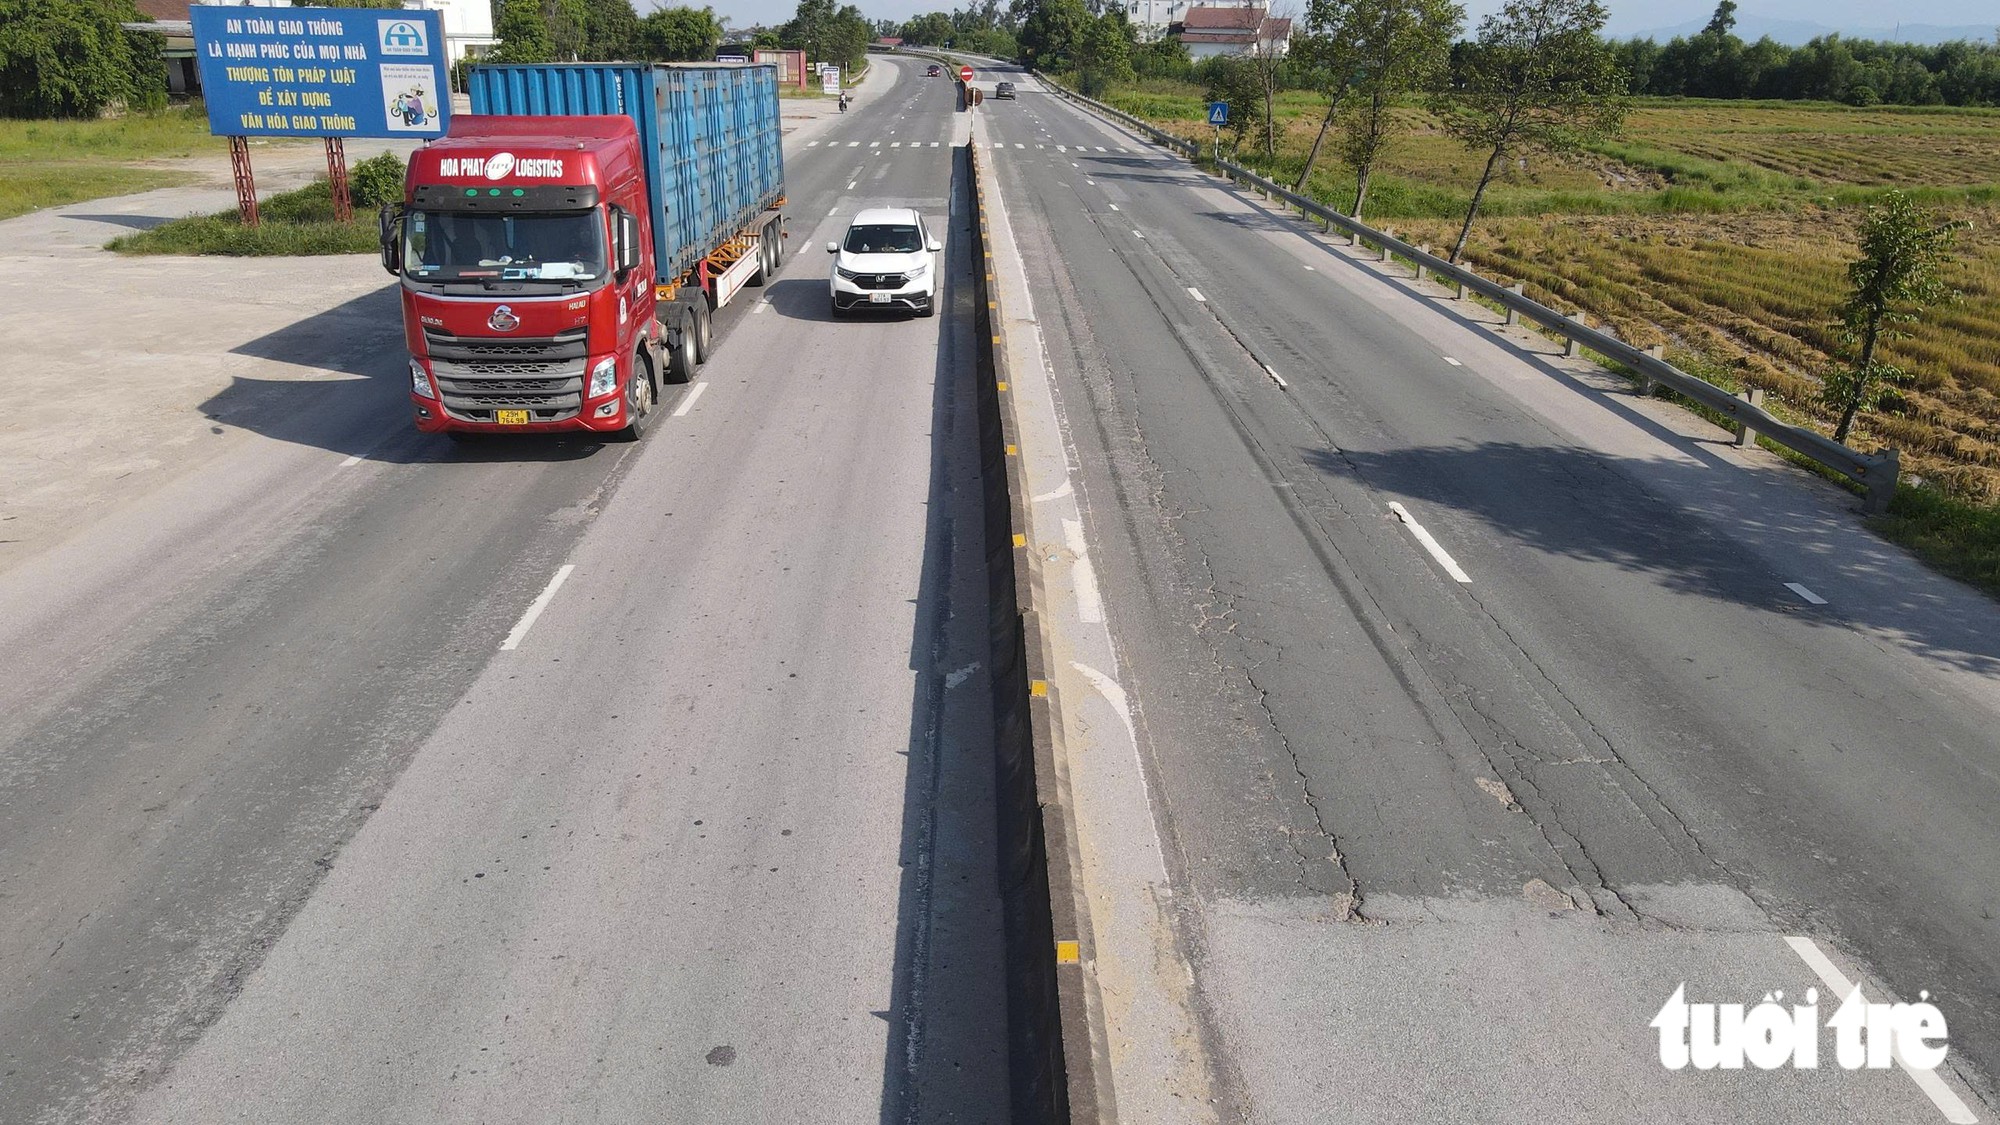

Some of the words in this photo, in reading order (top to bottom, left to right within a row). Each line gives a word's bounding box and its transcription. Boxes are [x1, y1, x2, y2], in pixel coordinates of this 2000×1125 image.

[227, 19, 242, 34] AN
[246, 17, 274, 35] TOÀN
[279, 20, 303, 35] GIAO
[307, 18, 343, 36] THÔNG
[208, 40, 223, 58] LÀ
[226, 43, 257, 61] HẠNH
[261, 41, 290, 59] PHÚC
[294, 40, 316, 60] CỦA
[319, 45, 340, 63] MỌI
[344, 42, 367, 60] NHÀ
[226, 66, 269, 85] THƯỢNG
[272, 65, 294, 83] TÔN
[298, 66, 326, 83] PHÁP
[330, 67, 356, 87] LUẬT
[258, 86, 274, 106] ĐỂ
[277, 89, 297, 106] XÂY
[302, 91, 332, 110] DỰNG
[240, 112, 263, 128] VĂN
[267, 112, 289, 129] HÓA
[292, 115, 317, 130] GIAO
[320, 113, 356, 130] THÔNG
[440, 158, 459, 177] HOA
[461, 158, 485, 177] PHAT
[515, 158, 563, 178] LOGISTICS
